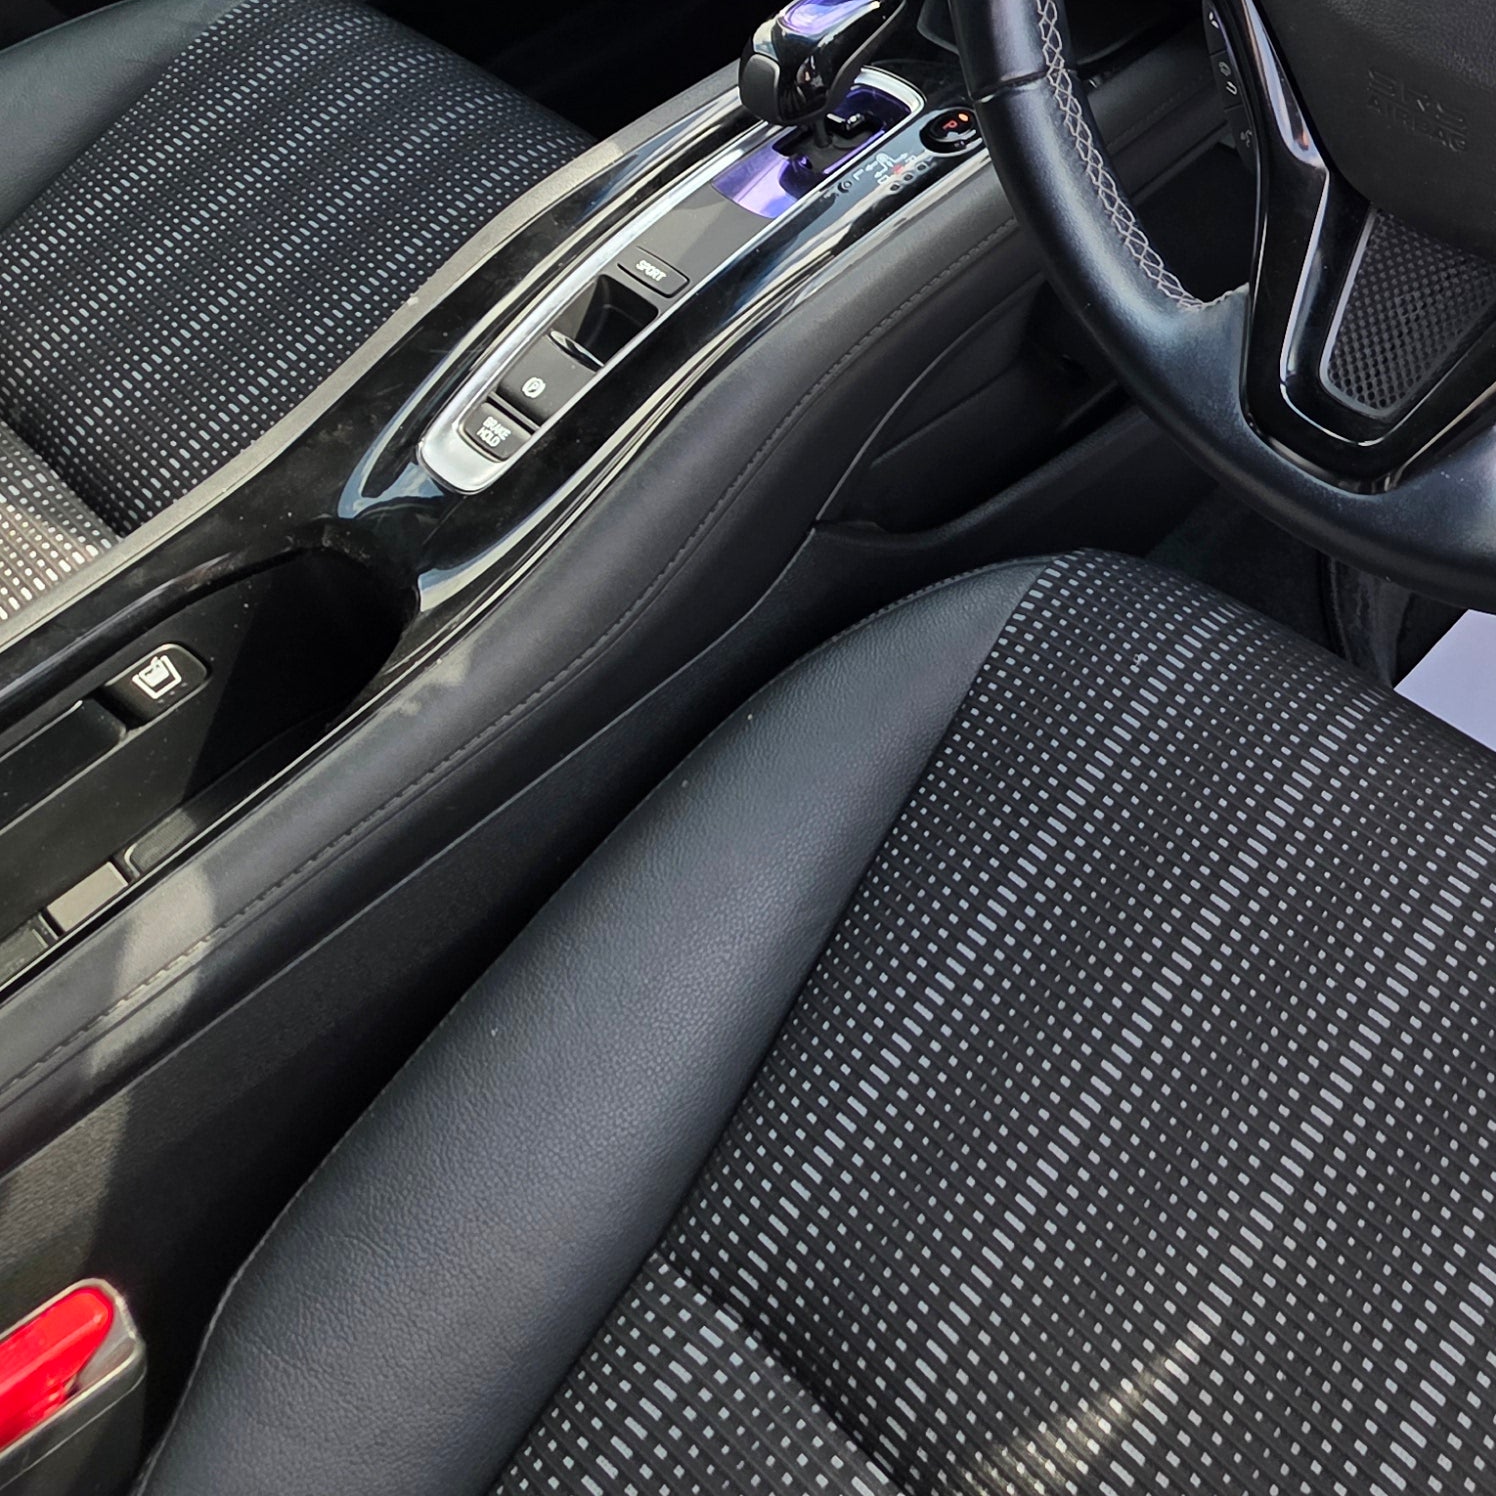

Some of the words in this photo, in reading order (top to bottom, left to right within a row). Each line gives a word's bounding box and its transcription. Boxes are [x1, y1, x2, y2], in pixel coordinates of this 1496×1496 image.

[635, 259, 667, 282] SPORT
[476, 426, 501, 448] HOLD
[482, 416, 512, 441] BRAKE
